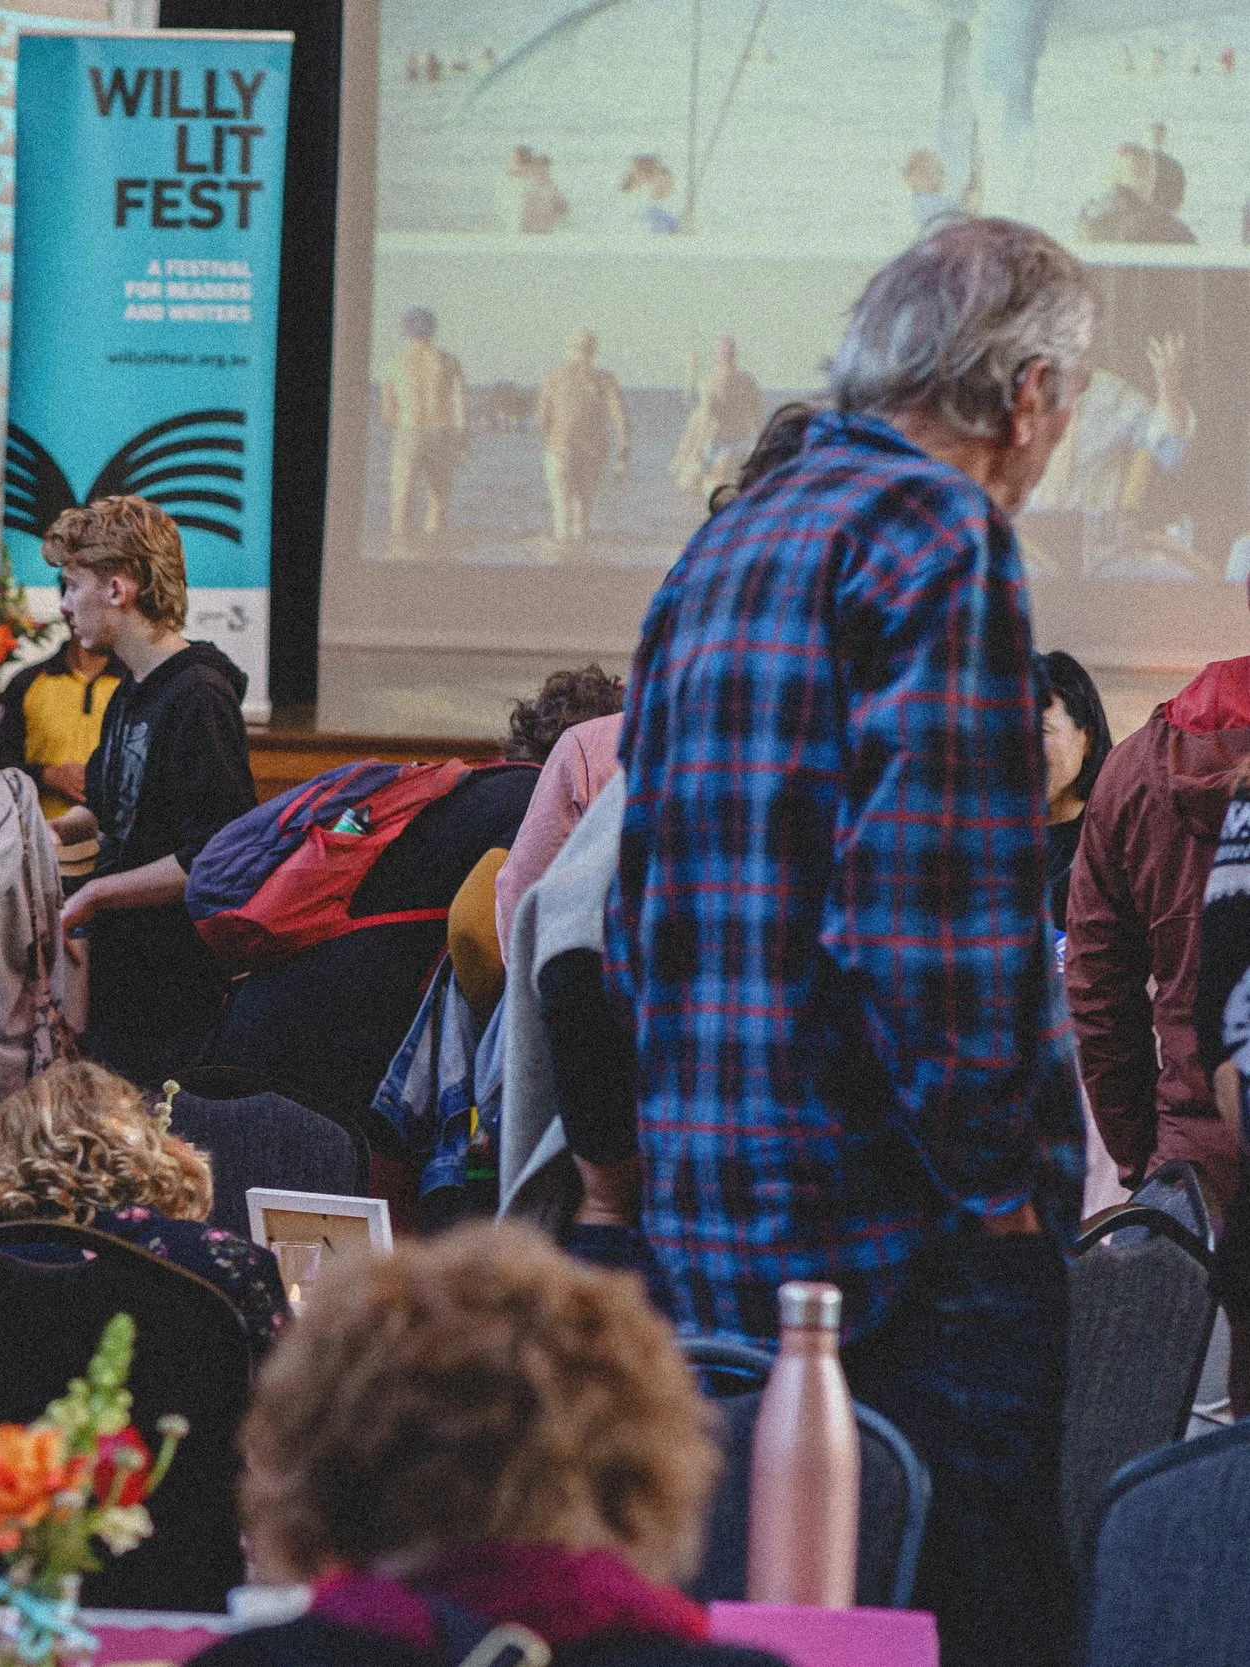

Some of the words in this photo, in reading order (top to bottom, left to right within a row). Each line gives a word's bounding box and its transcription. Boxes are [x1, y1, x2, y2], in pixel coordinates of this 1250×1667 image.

[88, 66, 267, 119] WILLY
[175, 124, 264, 175] LIT
[114, 177, 263, 230] FEST
[146, 259, 162, 277] A
[166, 259, 252, 278] FESTIVAL
[124, 281, 162, 299] FOR
[166, 281, 252, 300] READERS
[123, 303, 164, 321] AND
[168, 304, 252, 323] WRITERS
